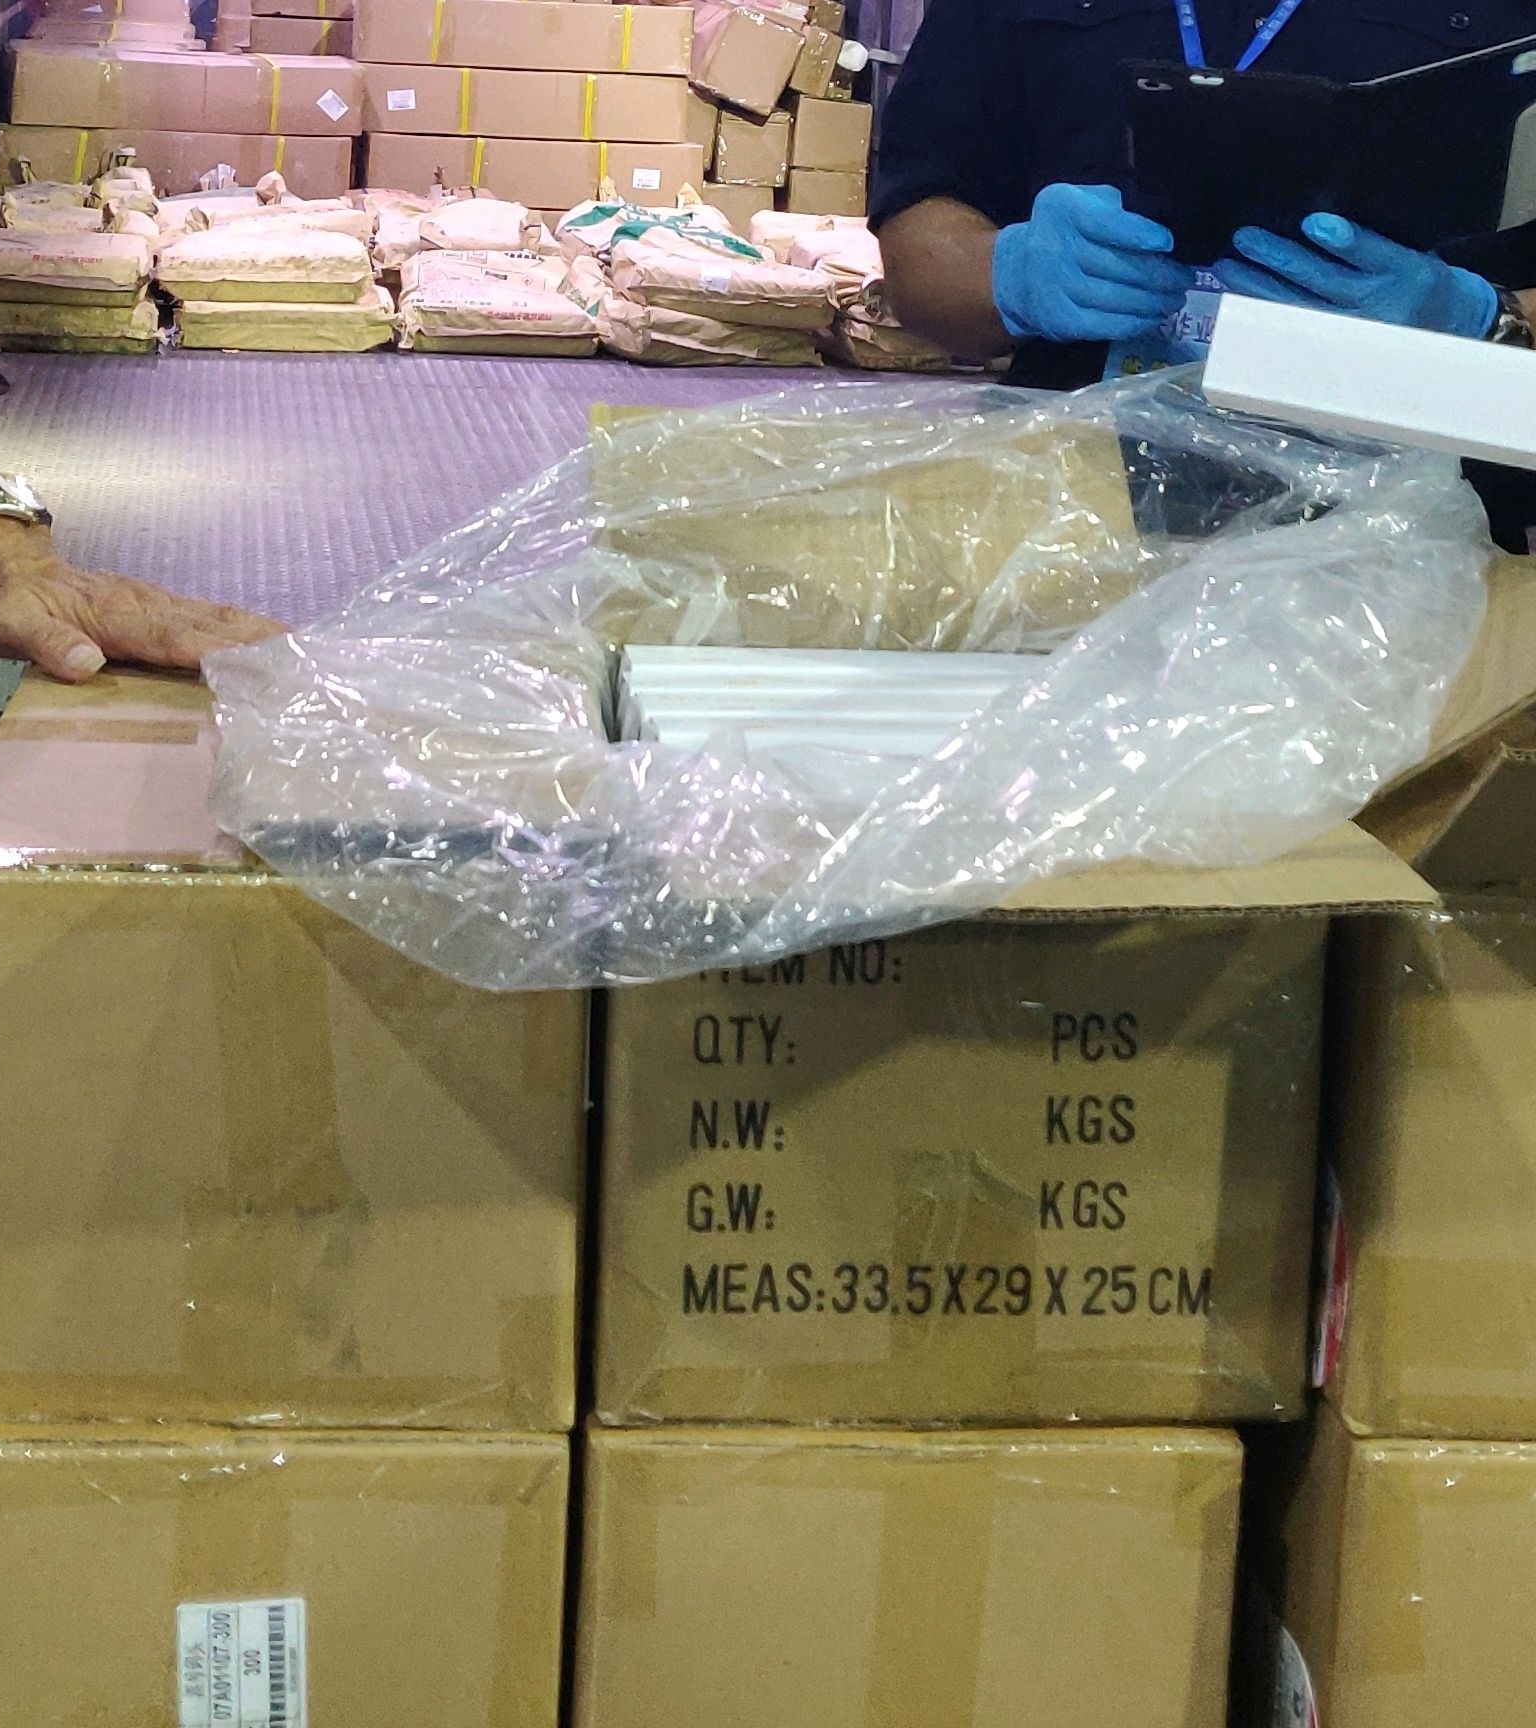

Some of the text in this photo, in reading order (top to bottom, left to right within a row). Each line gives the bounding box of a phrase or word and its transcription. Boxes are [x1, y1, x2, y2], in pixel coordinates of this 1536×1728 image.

[828, 938, 904, 985] NO:
[693, 1012, 1137, 1065] QTY: PCS
[689, 1095, 1136, 1150] N.W: KGS
[686, 1180, 1128, 1233] G.W: KGS
[243, 1649, 262, 1676] 300
